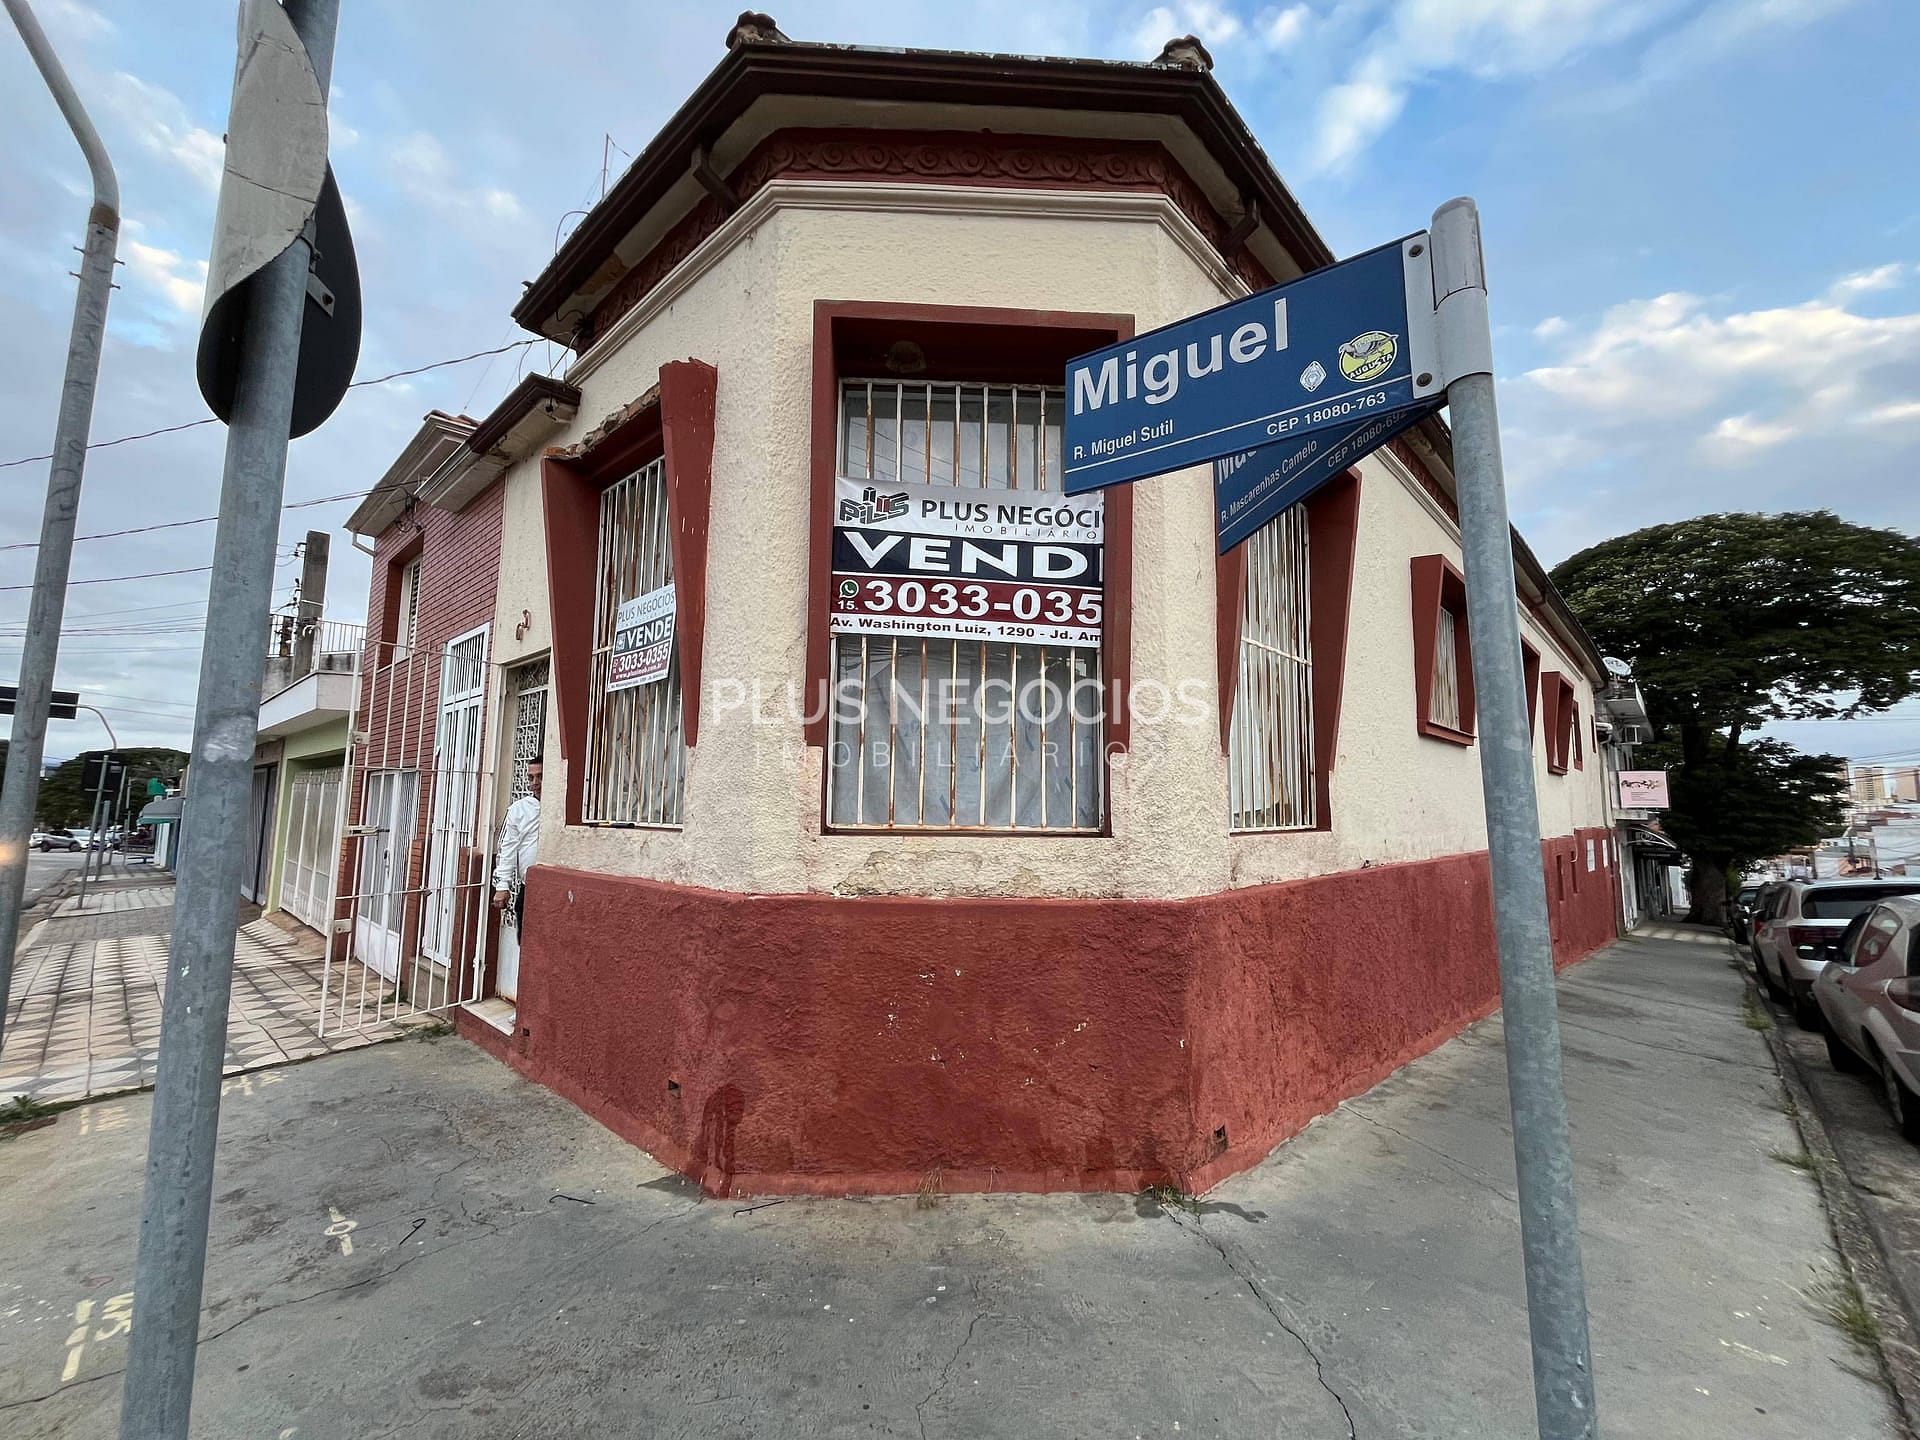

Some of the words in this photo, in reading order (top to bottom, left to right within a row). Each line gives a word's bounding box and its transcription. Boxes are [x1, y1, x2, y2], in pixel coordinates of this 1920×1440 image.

[1074, 297, 1289, 416] Miguel
[1350, 353, 1393, 379] AUGUSTA
[1266, 417, 1299, 436] CEP
[1304, 391, 1387, 426] 18080-763
[1074, 445, 1087, 461] R.
[1091, 429, 1136, 456] Miguel
[1140, 418, 1173, 442] Sutil
[1327, 445, 1348, 468] CEP
[1221, 509, 1229, 524] R.
[1229, 468, 1281, 517] Mascarenhas
[1281, 440, 1318, 475] Camelo
[921, 499, 989, 523] PLUS
[997, 504, 1104, 529] NEGÓCI
[843, 531, 1103, 582] VEND
[618, 607, 634, 623] PLUS
[637, 593, 674, 615] NEGÓCIOS
[837, 600, 859, 611] 15.
[627, 615, 672, 648] VENDE
[830, 617, 853, 628] Av.
[858, 618, 951, 633] Washington
[955, 623, 991, 636] Luiz,
[997, 625, 1035, 637] 1290
[1049, 629, 1073, 640] Jd.
[619, 643, 669, 672] 3033-0355
